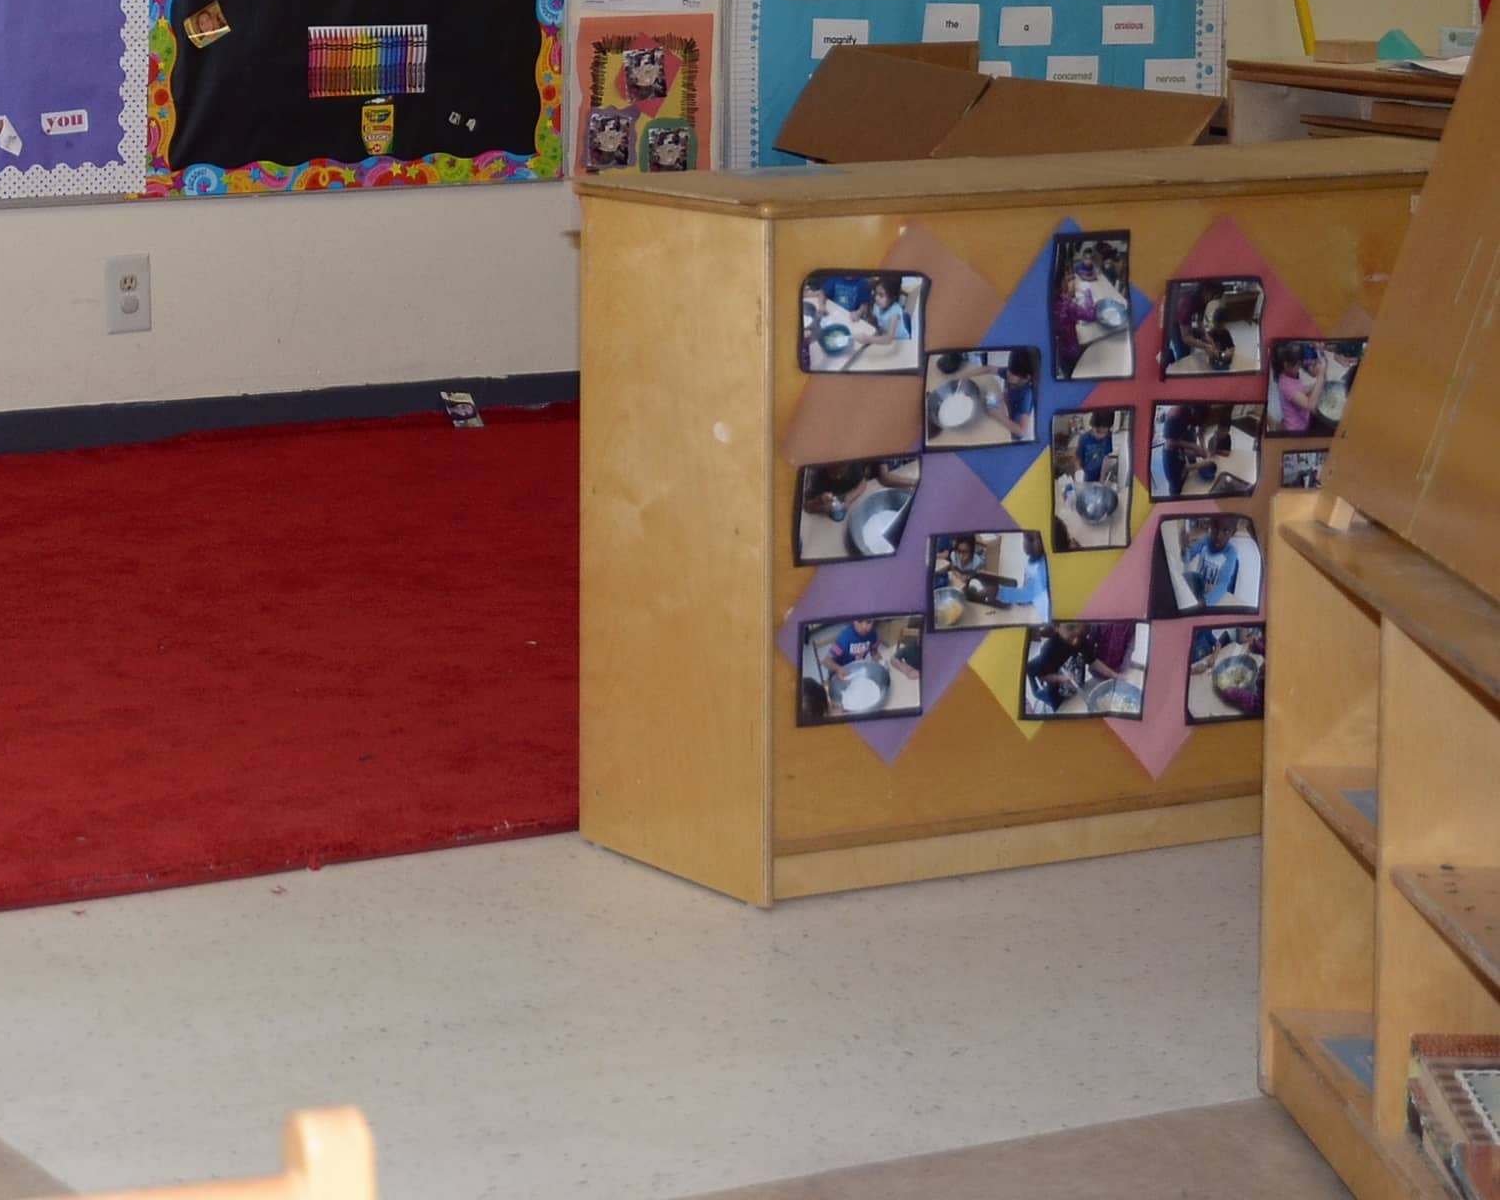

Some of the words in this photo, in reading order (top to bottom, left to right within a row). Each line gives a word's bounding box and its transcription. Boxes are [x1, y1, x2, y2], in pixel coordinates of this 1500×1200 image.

[945, 20, 959, 28] the
[1114, 21, 1143, 30] anxious
[823, 35, 858, 45] magnify
[1053, 72, 1092, 80] concerned
[47, 115, 84, 133] you
